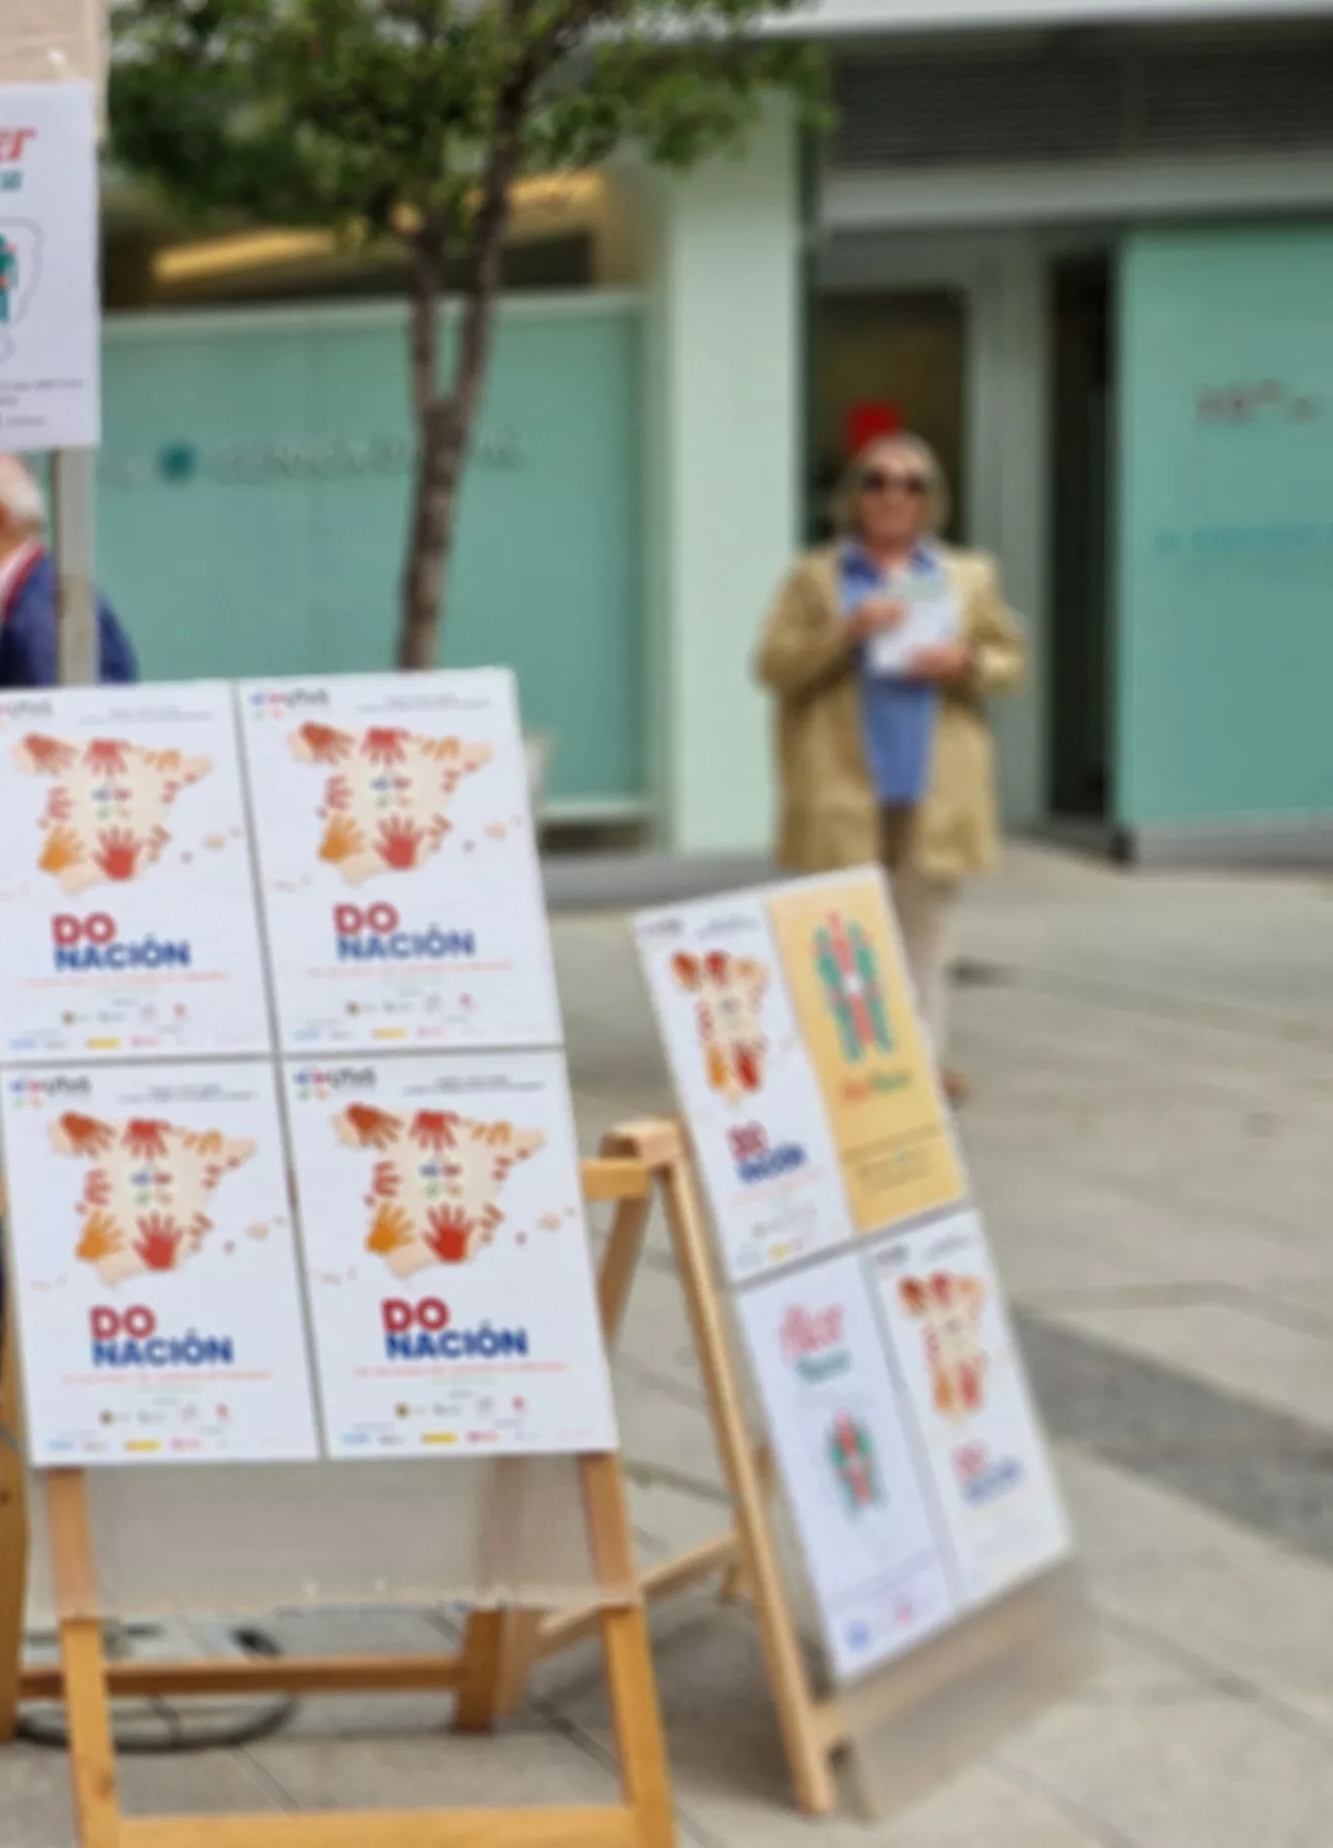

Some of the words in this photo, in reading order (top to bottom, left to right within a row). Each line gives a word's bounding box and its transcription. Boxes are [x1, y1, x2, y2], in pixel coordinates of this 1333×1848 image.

[52, 912, 117, 945] DO
[332, 901, 399, 935] DO
[53, 932, 190, 971] NACIÓN
[337, 922, 475, 963] NACIÓN
[89, 1304, 156, 1340] DO
[381, 1295, 450, 1332] DO
[91, 1327, 233, 1368] NACIÓN
[385, 1320, 528, 1360] NACIÓN
